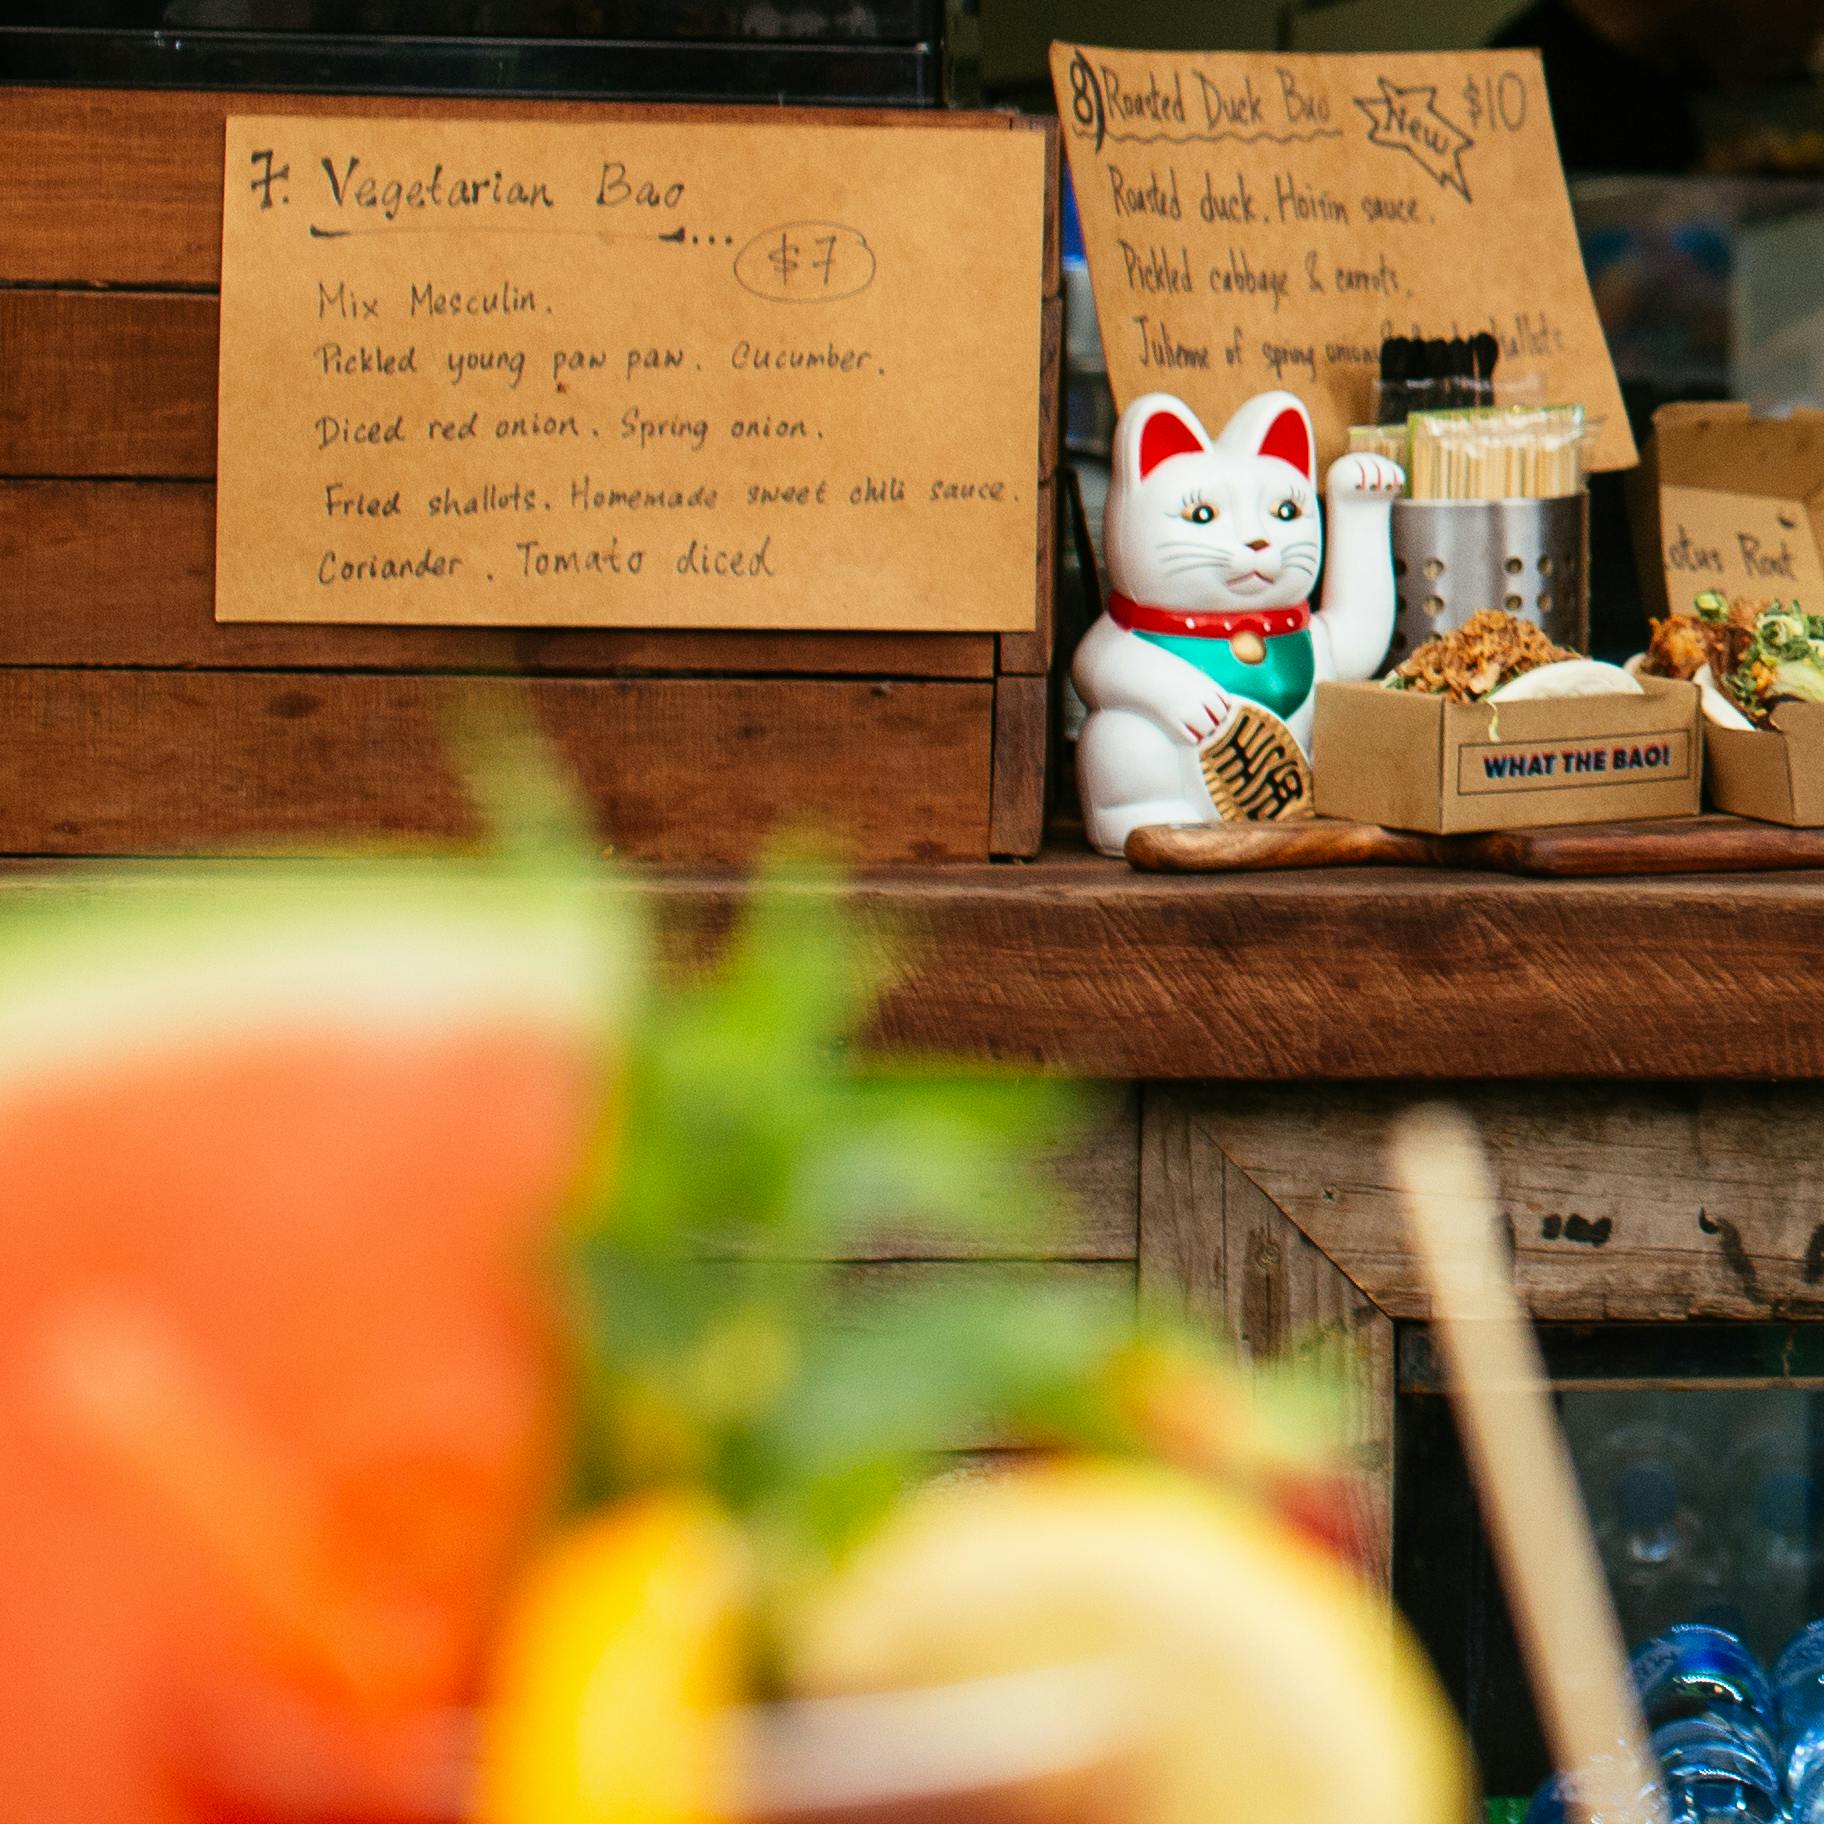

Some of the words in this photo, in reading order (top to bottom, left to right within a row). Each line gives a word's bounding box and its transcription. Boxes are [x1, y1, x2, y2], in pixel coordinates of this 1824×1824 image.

[1192, 69, 1263, 130] Duck
[1463, 71, 1527, 132] $10
[321, 156, 554, 221] Vegetarian
[595, 162, 686, 209] Bao
[1118, 238, 1193, 295] Pickled
[1209, 246, 1290, 313] cabbage
[318, 281, 379, 320] Mix
[314, 342, 416, 376] Pickled
[447, 346, 526, 389] young
[552, 347, 608, 385] paw
[315, 415, 405, 451] Diced
[428, 410, 479, 441] red
[621, 405, 709, 453] Spring
[324, 482, 401, 518] Fried
[571, 474, 719, 511] Homemade
[747, 479, 827, 507] sweet
[516, 536, 646, 577] Tomato
[676, 535, 775, 577] diced
[1664, 524, 1724, 573] otus
[1483, 752, 1557, 780] WHAT
[1561, 748, 1608, 774] THE
[1613, 741, 1671, 771] BAO!
